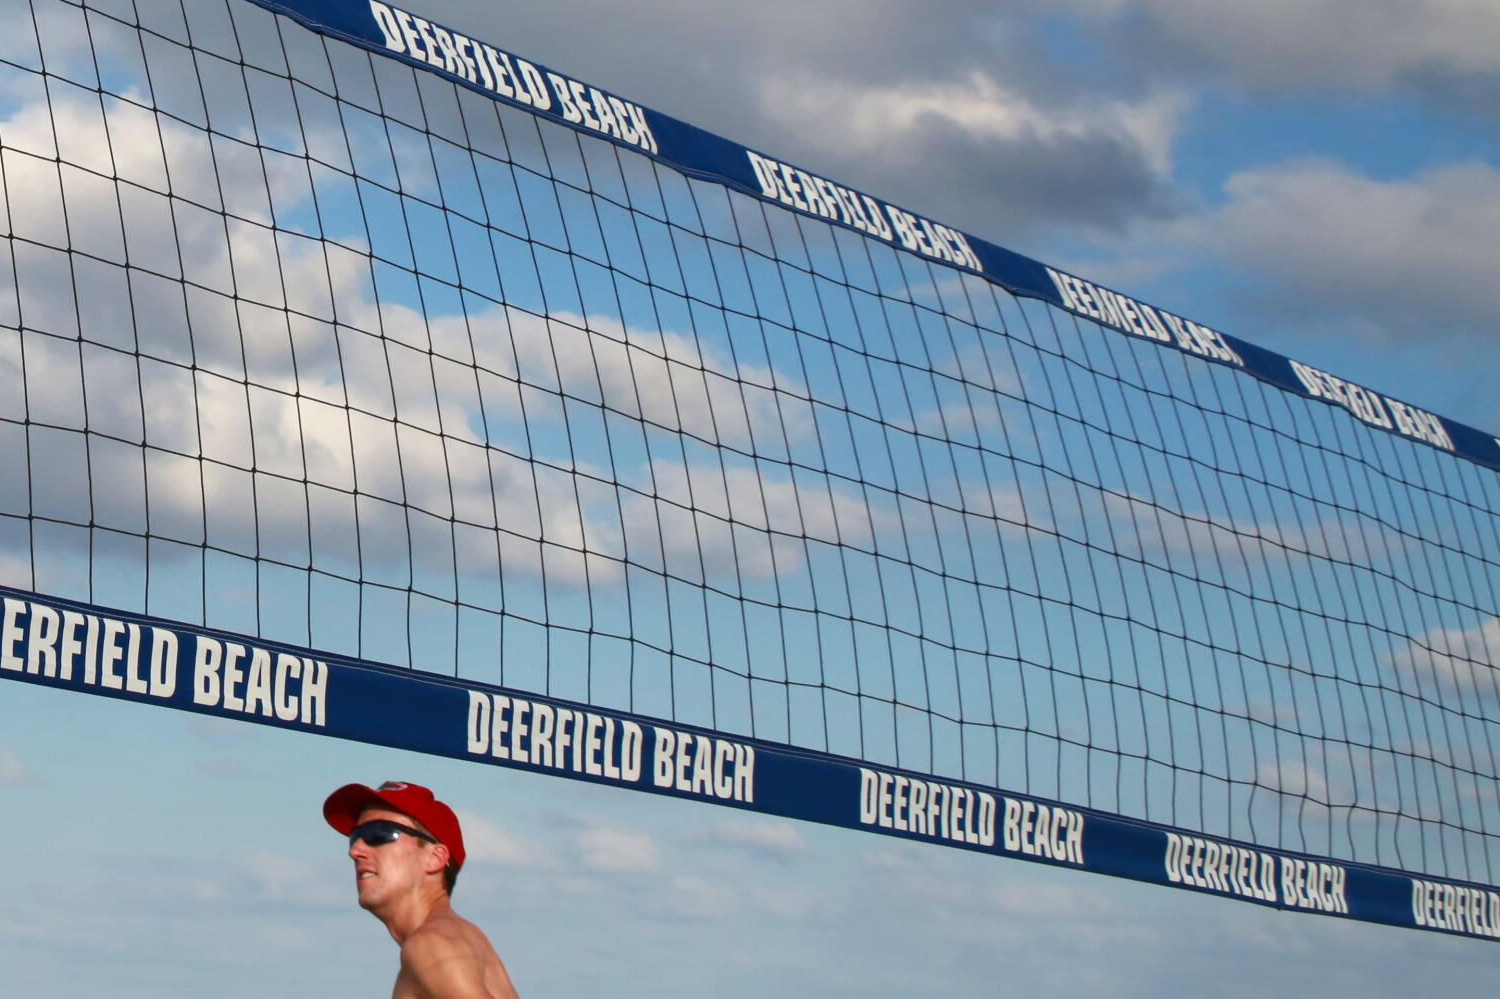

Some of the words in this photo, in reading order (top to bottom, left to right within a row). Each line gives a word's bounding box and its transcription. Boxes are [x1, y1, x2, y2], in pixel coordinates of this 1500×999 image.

[368, 0, 551, 111] DEERFIELD
[547, 72, 658, 155] BEACH
[746, 150, 893, 242] DEERFIELD
[885, 204, 984, 273] BEACH
[193, 635, 329, 728] BEACH
[467, 689, 644, 783] DEERFIELD
[652, 726, 755, 803] BEACH
[859, 767, 997, 847] DEERFIELD
[1003, 797, 1085, 865] BEACH
[1165, 832, 1278, 903] DEERFIELD
[1280, 855, 1349, 915] BEACH
[1411, 879, 1500, 938] DEERFIELD
